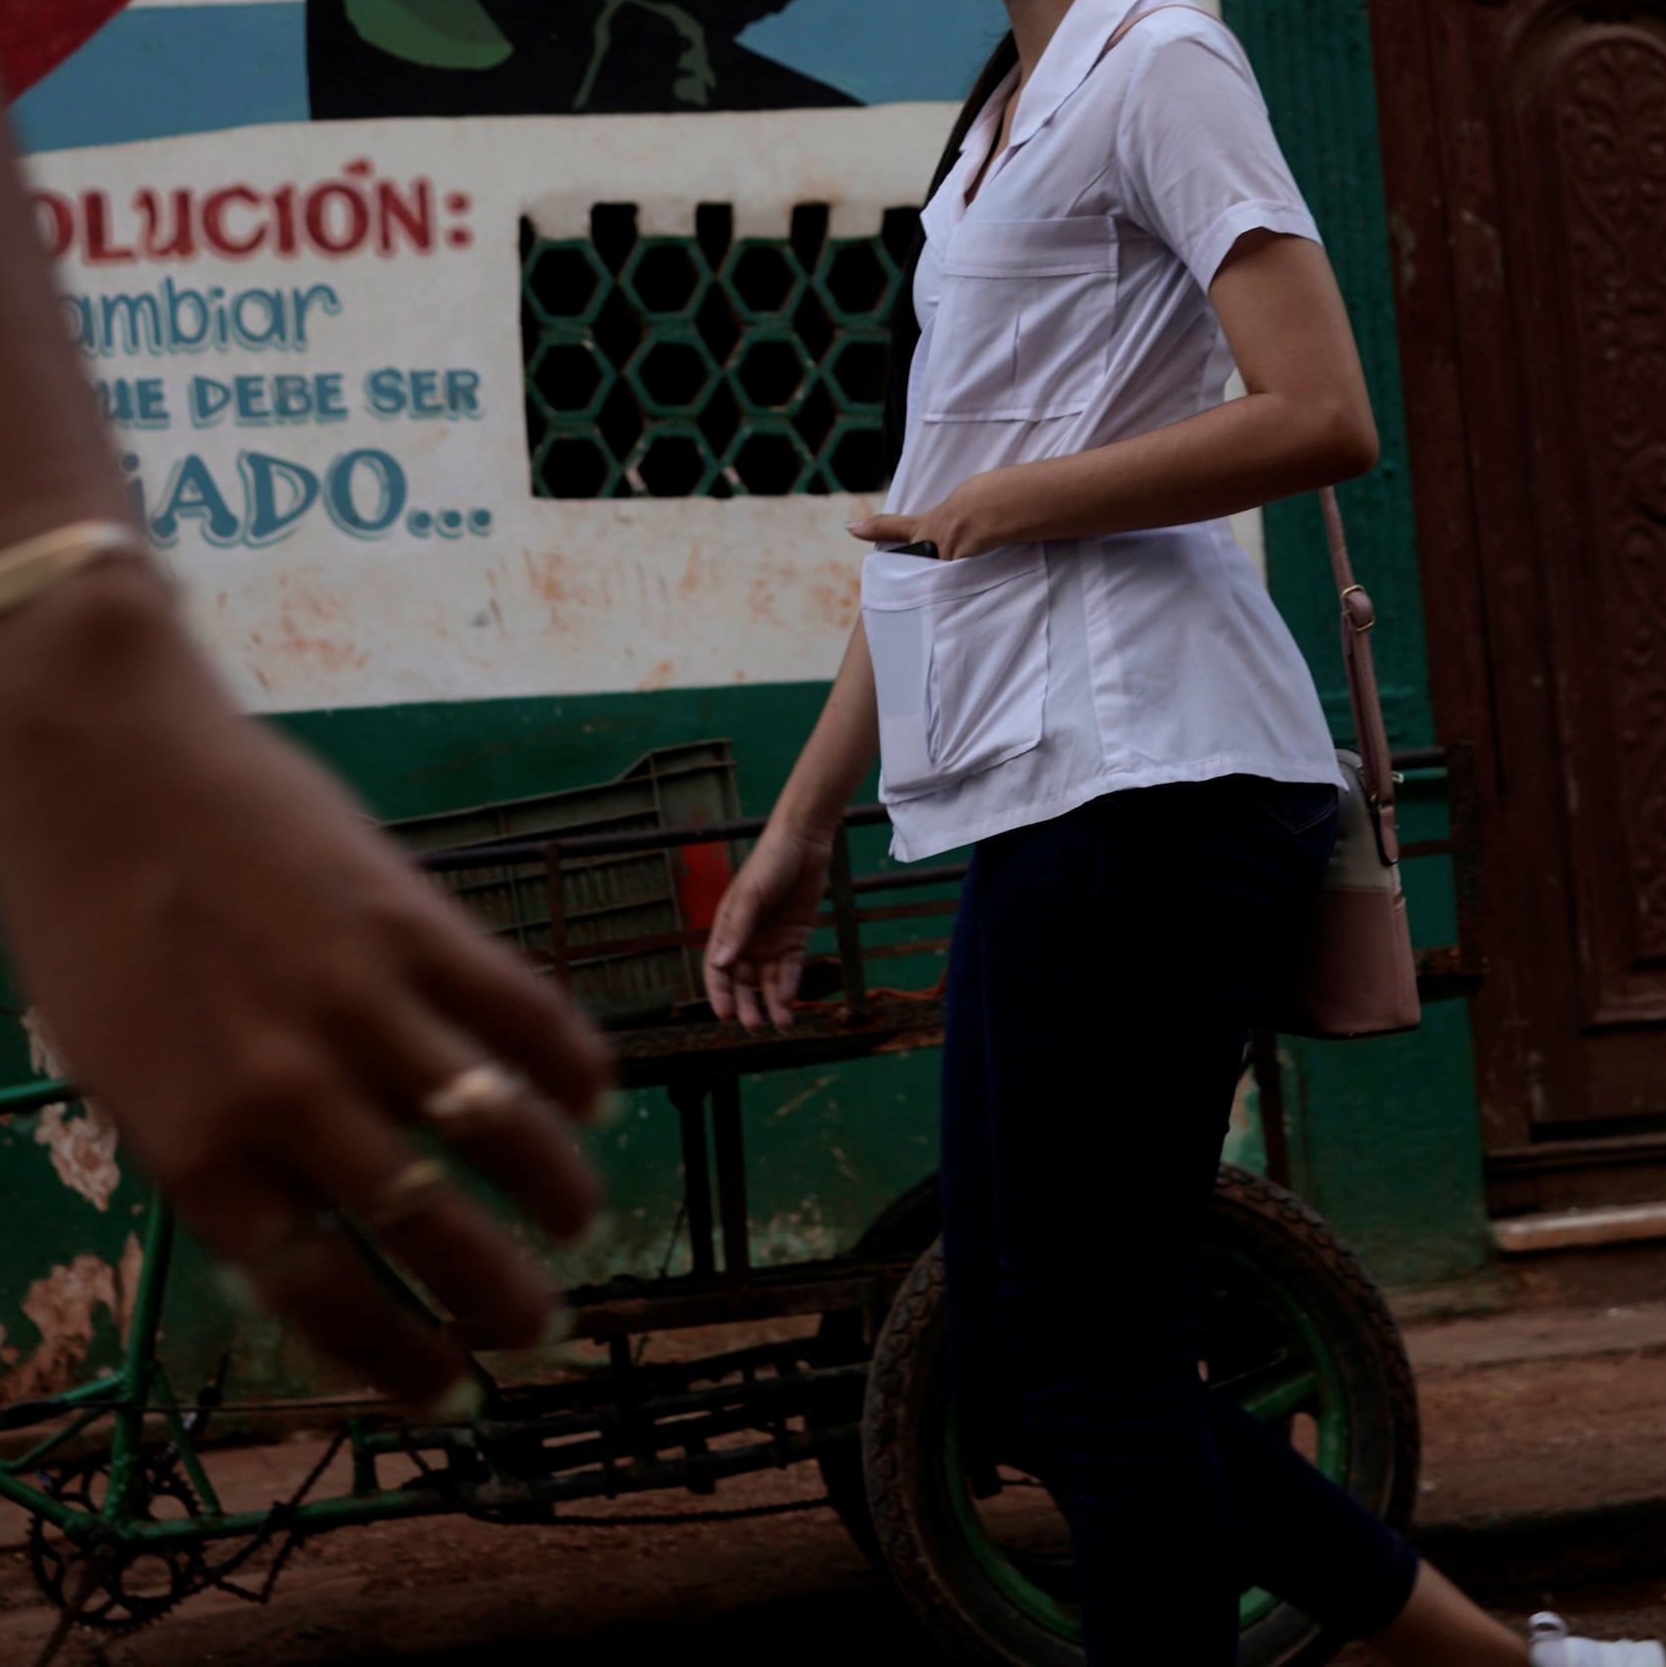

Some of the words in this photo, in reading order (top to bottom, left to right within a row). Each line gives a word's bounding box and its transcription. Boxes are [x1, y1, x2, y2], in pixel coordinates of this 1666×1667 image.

[28, 157, 470, 262] OLUCIÓN:
[59, 275, 342, 359] ambiar
[96, 377, 171, 429] UE
[189, 372, 349, 429] DEBE
[365, 367, 482, 420] SER
